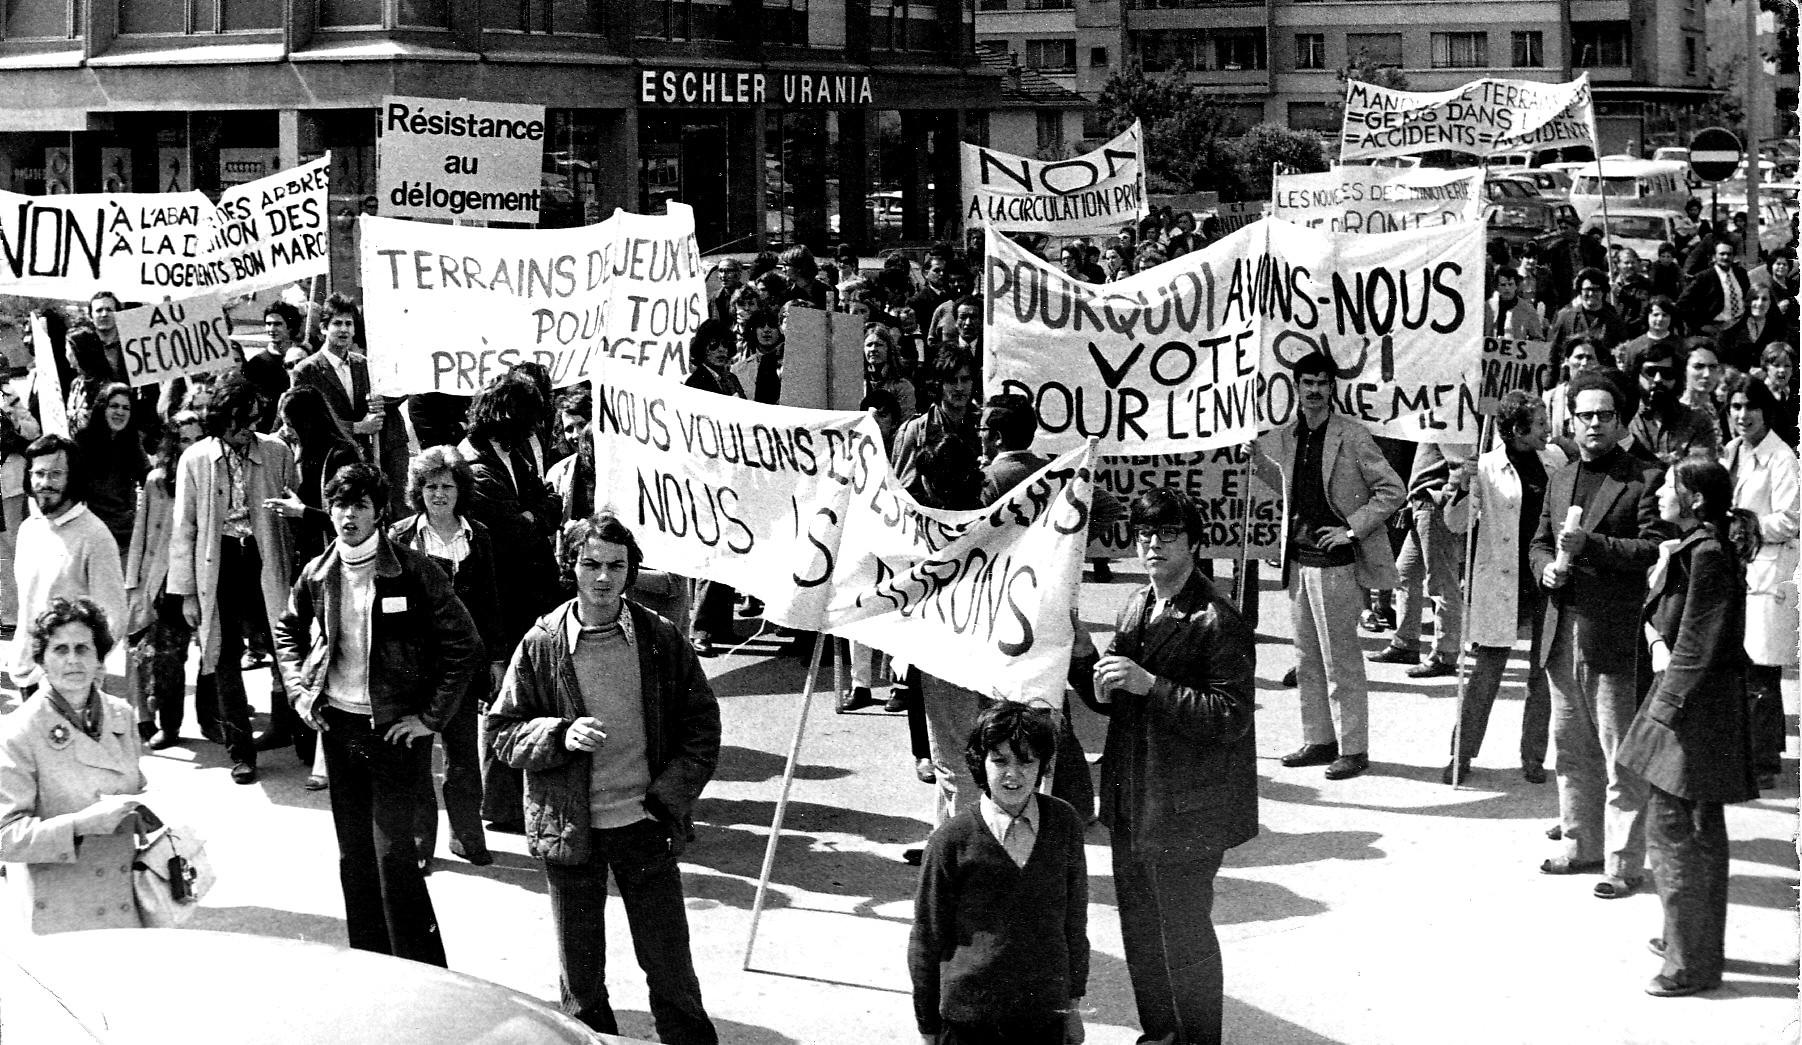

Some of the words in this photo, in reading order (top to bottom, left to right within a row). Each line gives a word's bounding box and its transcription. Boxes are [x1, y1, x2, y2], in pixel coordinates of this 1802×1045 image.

[642, 71, 766, 103] ESCHLER
[783, 75, 873, 103] URANIA
[388, 103, 544, 140] Résistance
[1446, 103, 1513, 131] DANS
[444, 155, 478, 175] au
[390, 181, 541, 214] délogement
[968, 195, 983, 220] A
[988, 195, 1006, 221] LA
[1008, 188, 1111, 222] CIRCULATION
[1277, 189, 1311, 209] LES
[0, 199, 105, 281] NON
[142, 233, 176, 256] LA
[265, 197, 321, 237] DES
[231, 249, 266, 281] BON
[377, 249, 577, 299] TERRAINS
[587, 242, 612, 291] DE
[613, 237, 681, 282] JEUX
[628, 292, 701, 337] TOUS
[986, 254, 1215, 341] POURQUOI
[149, 303, 186, 329] AU
[1087, 319, 1255, 390] VOTÉ
[1272, 329, 1395, 383] OUI
[1483, 337, 1528, 360] DES
[599, 383, 671, 453] NOUS
[676, 409, 818, 477] VOULONS
[1093, 468, 1204, 497] MUSEE
[637, 465, 754, 555] NOUS
